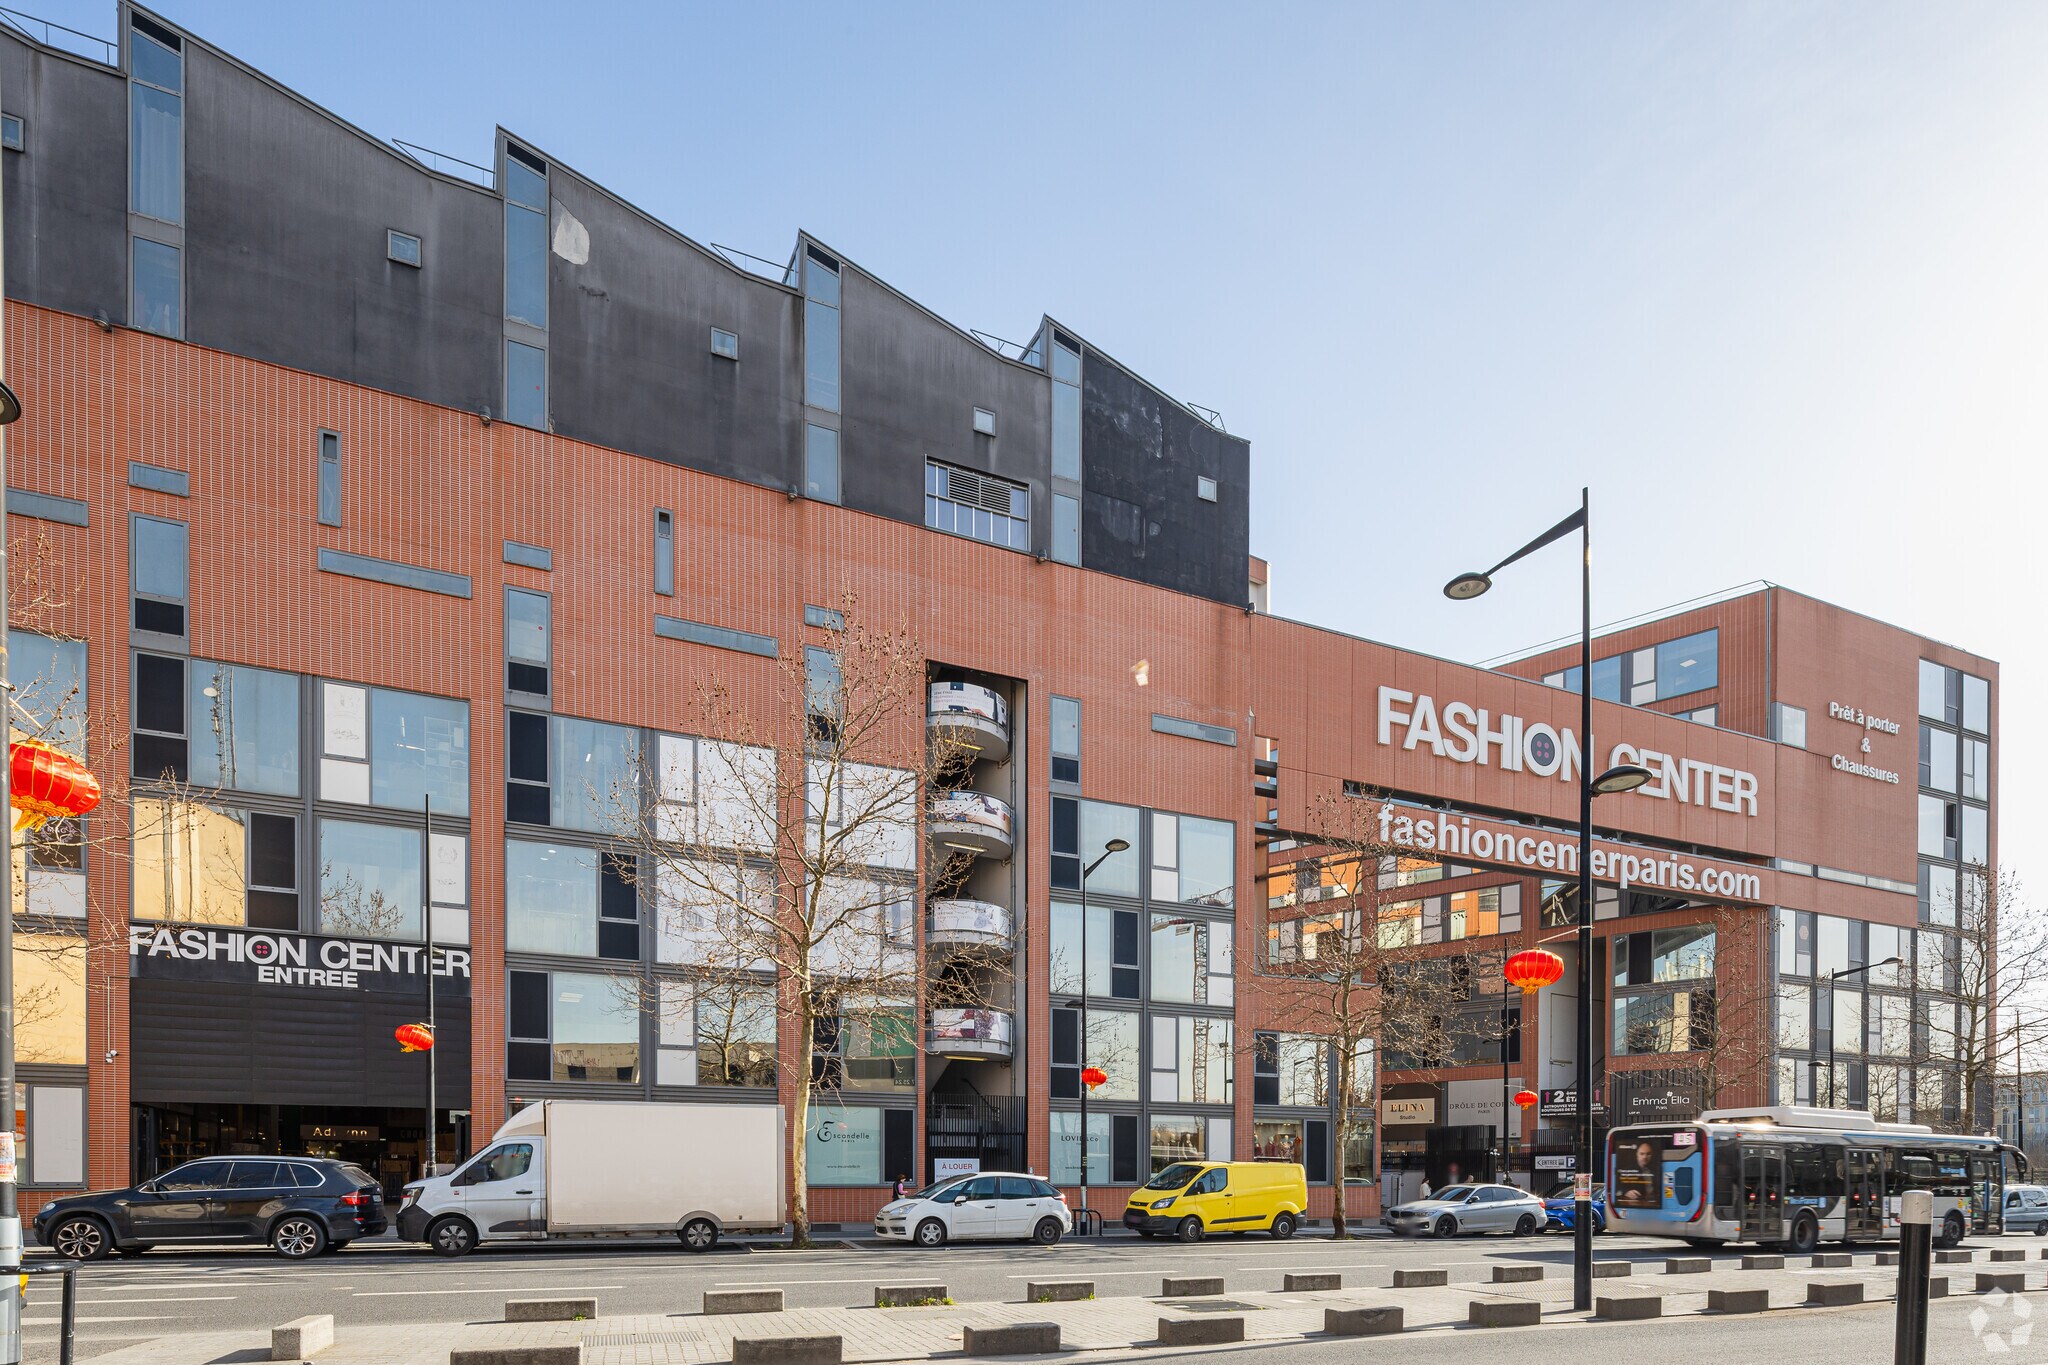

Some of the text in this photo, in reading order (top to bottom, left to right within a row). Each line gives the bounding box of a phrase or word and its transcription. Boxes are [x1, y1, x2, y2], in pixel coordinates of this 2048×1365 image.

[1829, 701, 1900, 735] Prêt à porter
[1378, 685, 1758, 816] FASHION CENTER
[1860, 737, 1871, 753] &
[1832, 753, 1899, 784] Chaussures
[1377, 803, 1760, 899] fashioncenerparis.com
[130, 925, 471, 977] FASHION CENTER
[258, 965, 358, 988] ENTREE
[1449, 1101, 1475, 1110] DRÔLE
[1553, 1090, 1565, 1103] 2
[1632, 1095, 1690, 1106] Emma Ella
[1390, 1103, 1425, 1112] ELINA
[1567, 1157, 1575, 1167] P
